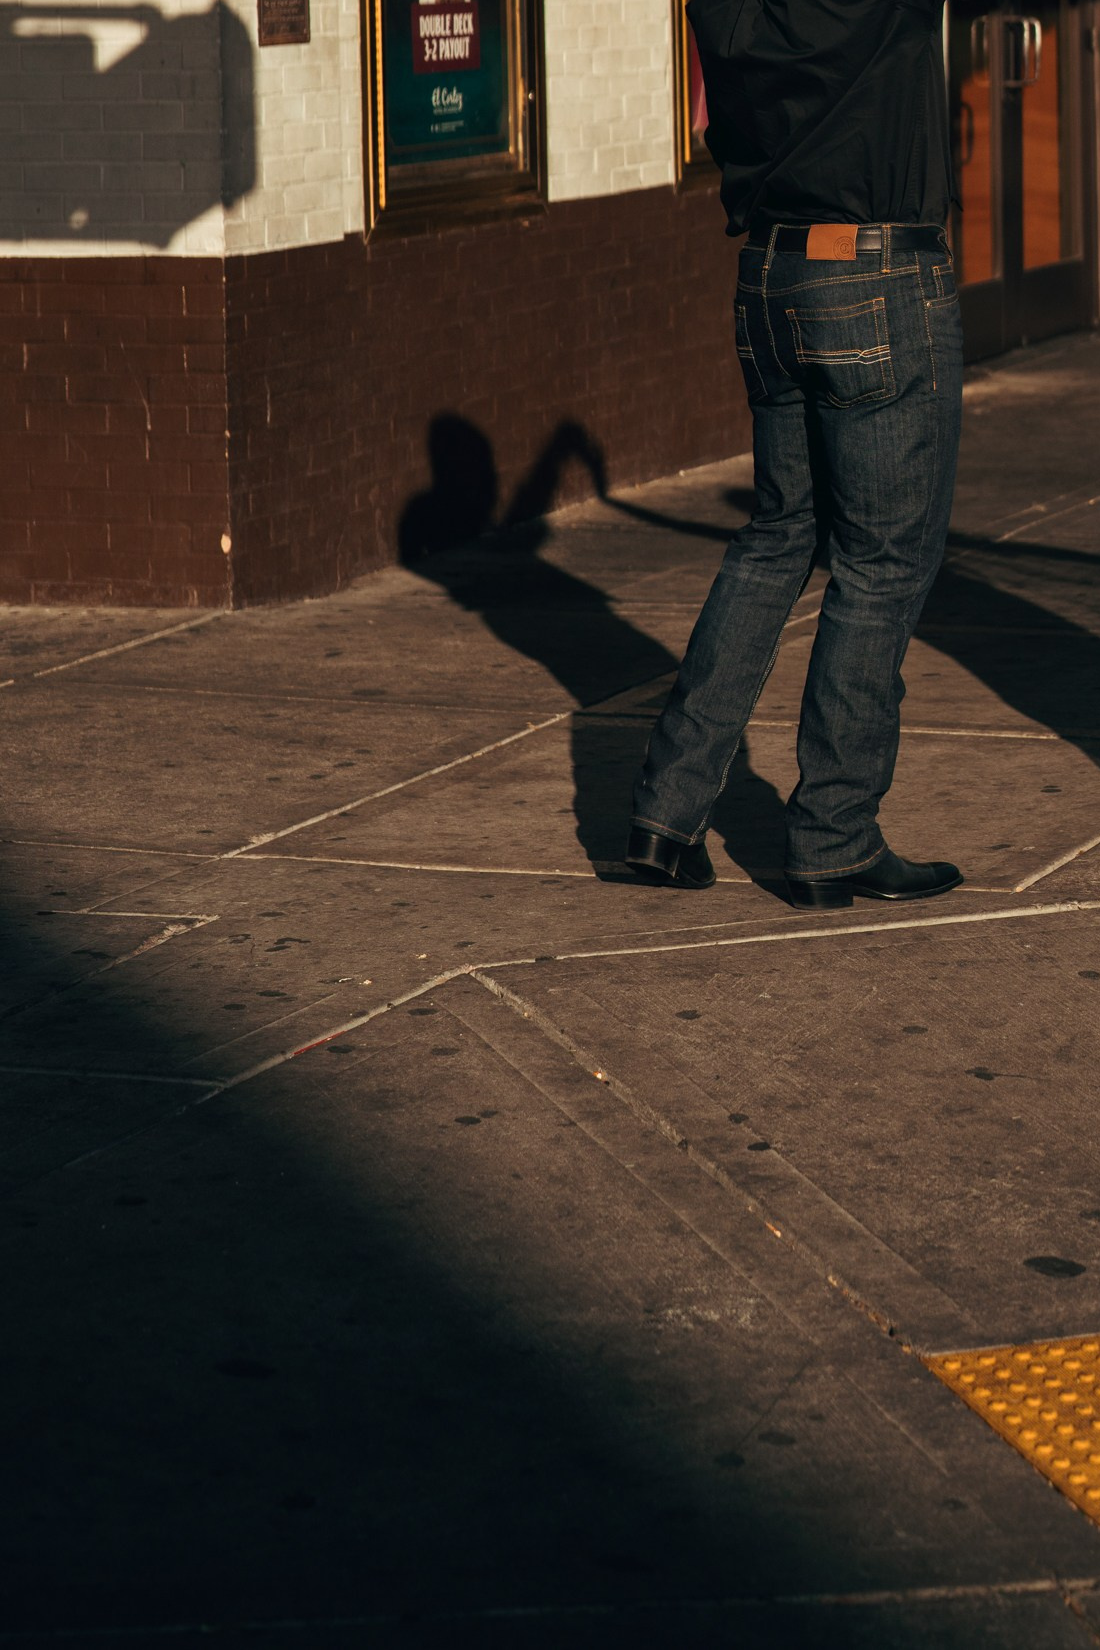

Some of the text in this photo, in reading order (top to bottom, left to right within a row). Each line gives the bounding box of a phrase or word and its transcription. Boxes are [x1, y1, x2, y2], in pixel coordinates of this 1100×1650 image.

[419, 12, 474, 39] DOUBLE DECK
[424, 36, 470, 62] 3-2 PAYOUT
